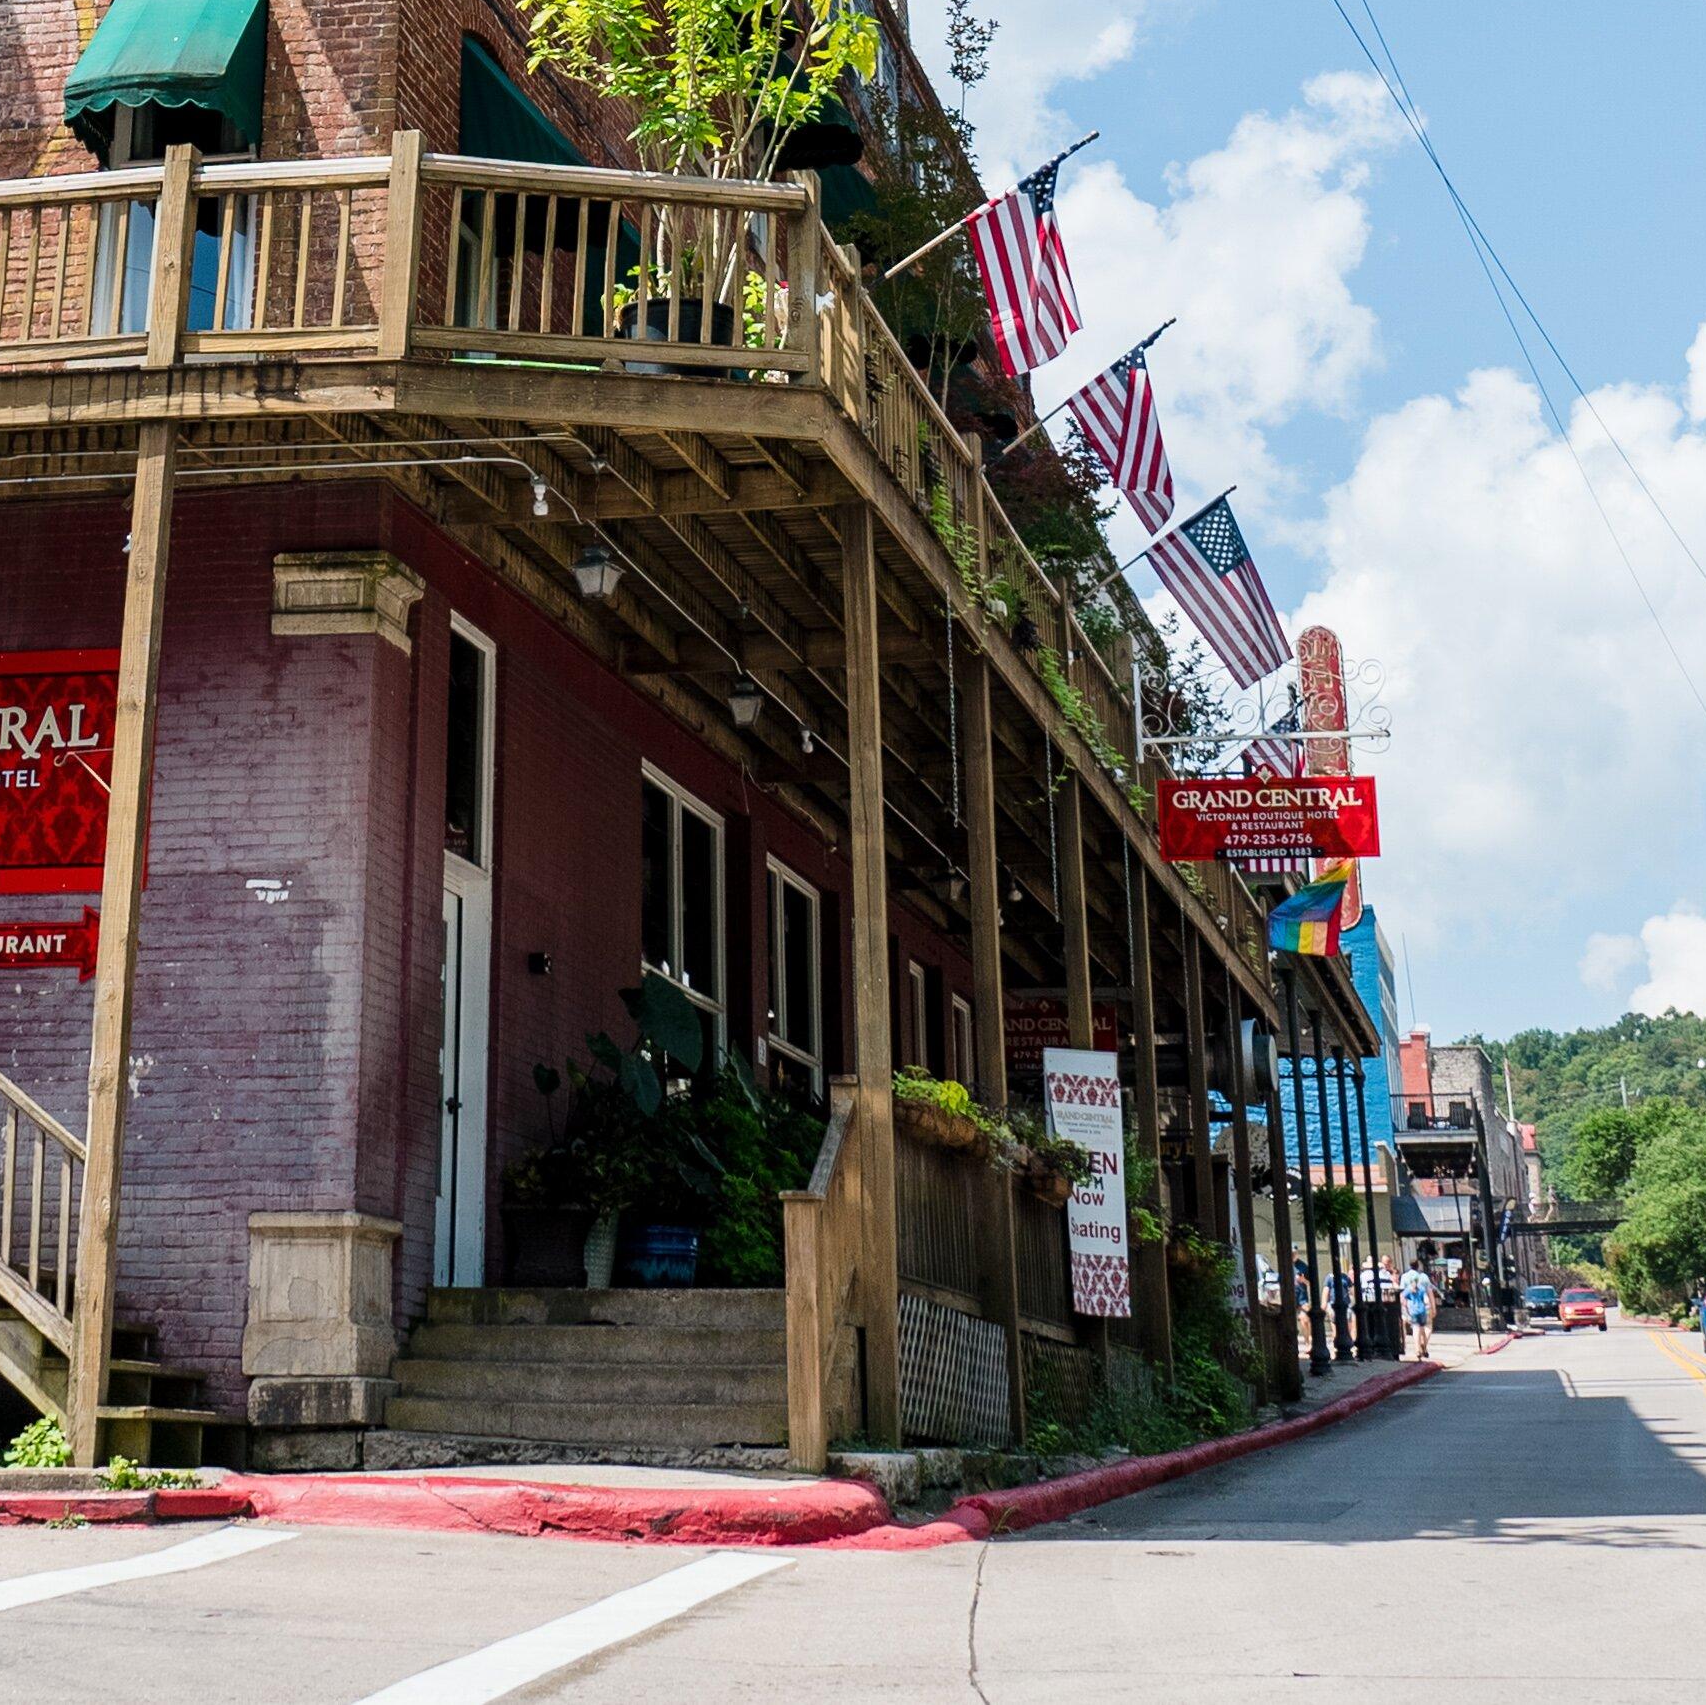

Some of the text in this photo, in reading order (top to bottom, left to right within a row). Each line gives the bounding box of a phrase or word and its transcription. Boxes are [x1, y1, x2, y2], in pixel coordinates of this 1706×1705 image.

[1172, 786, 1363, 813] GRAND CENTRAL
[1196, 810, 1340, 822] VICTORIAN BOUTIQUE HOTEL
[1241, 820, 1305, 831] RESTAURANT
[1003, 1017, 1035, 1032] AND
[1089, 1151, 1118, 1175] EN
